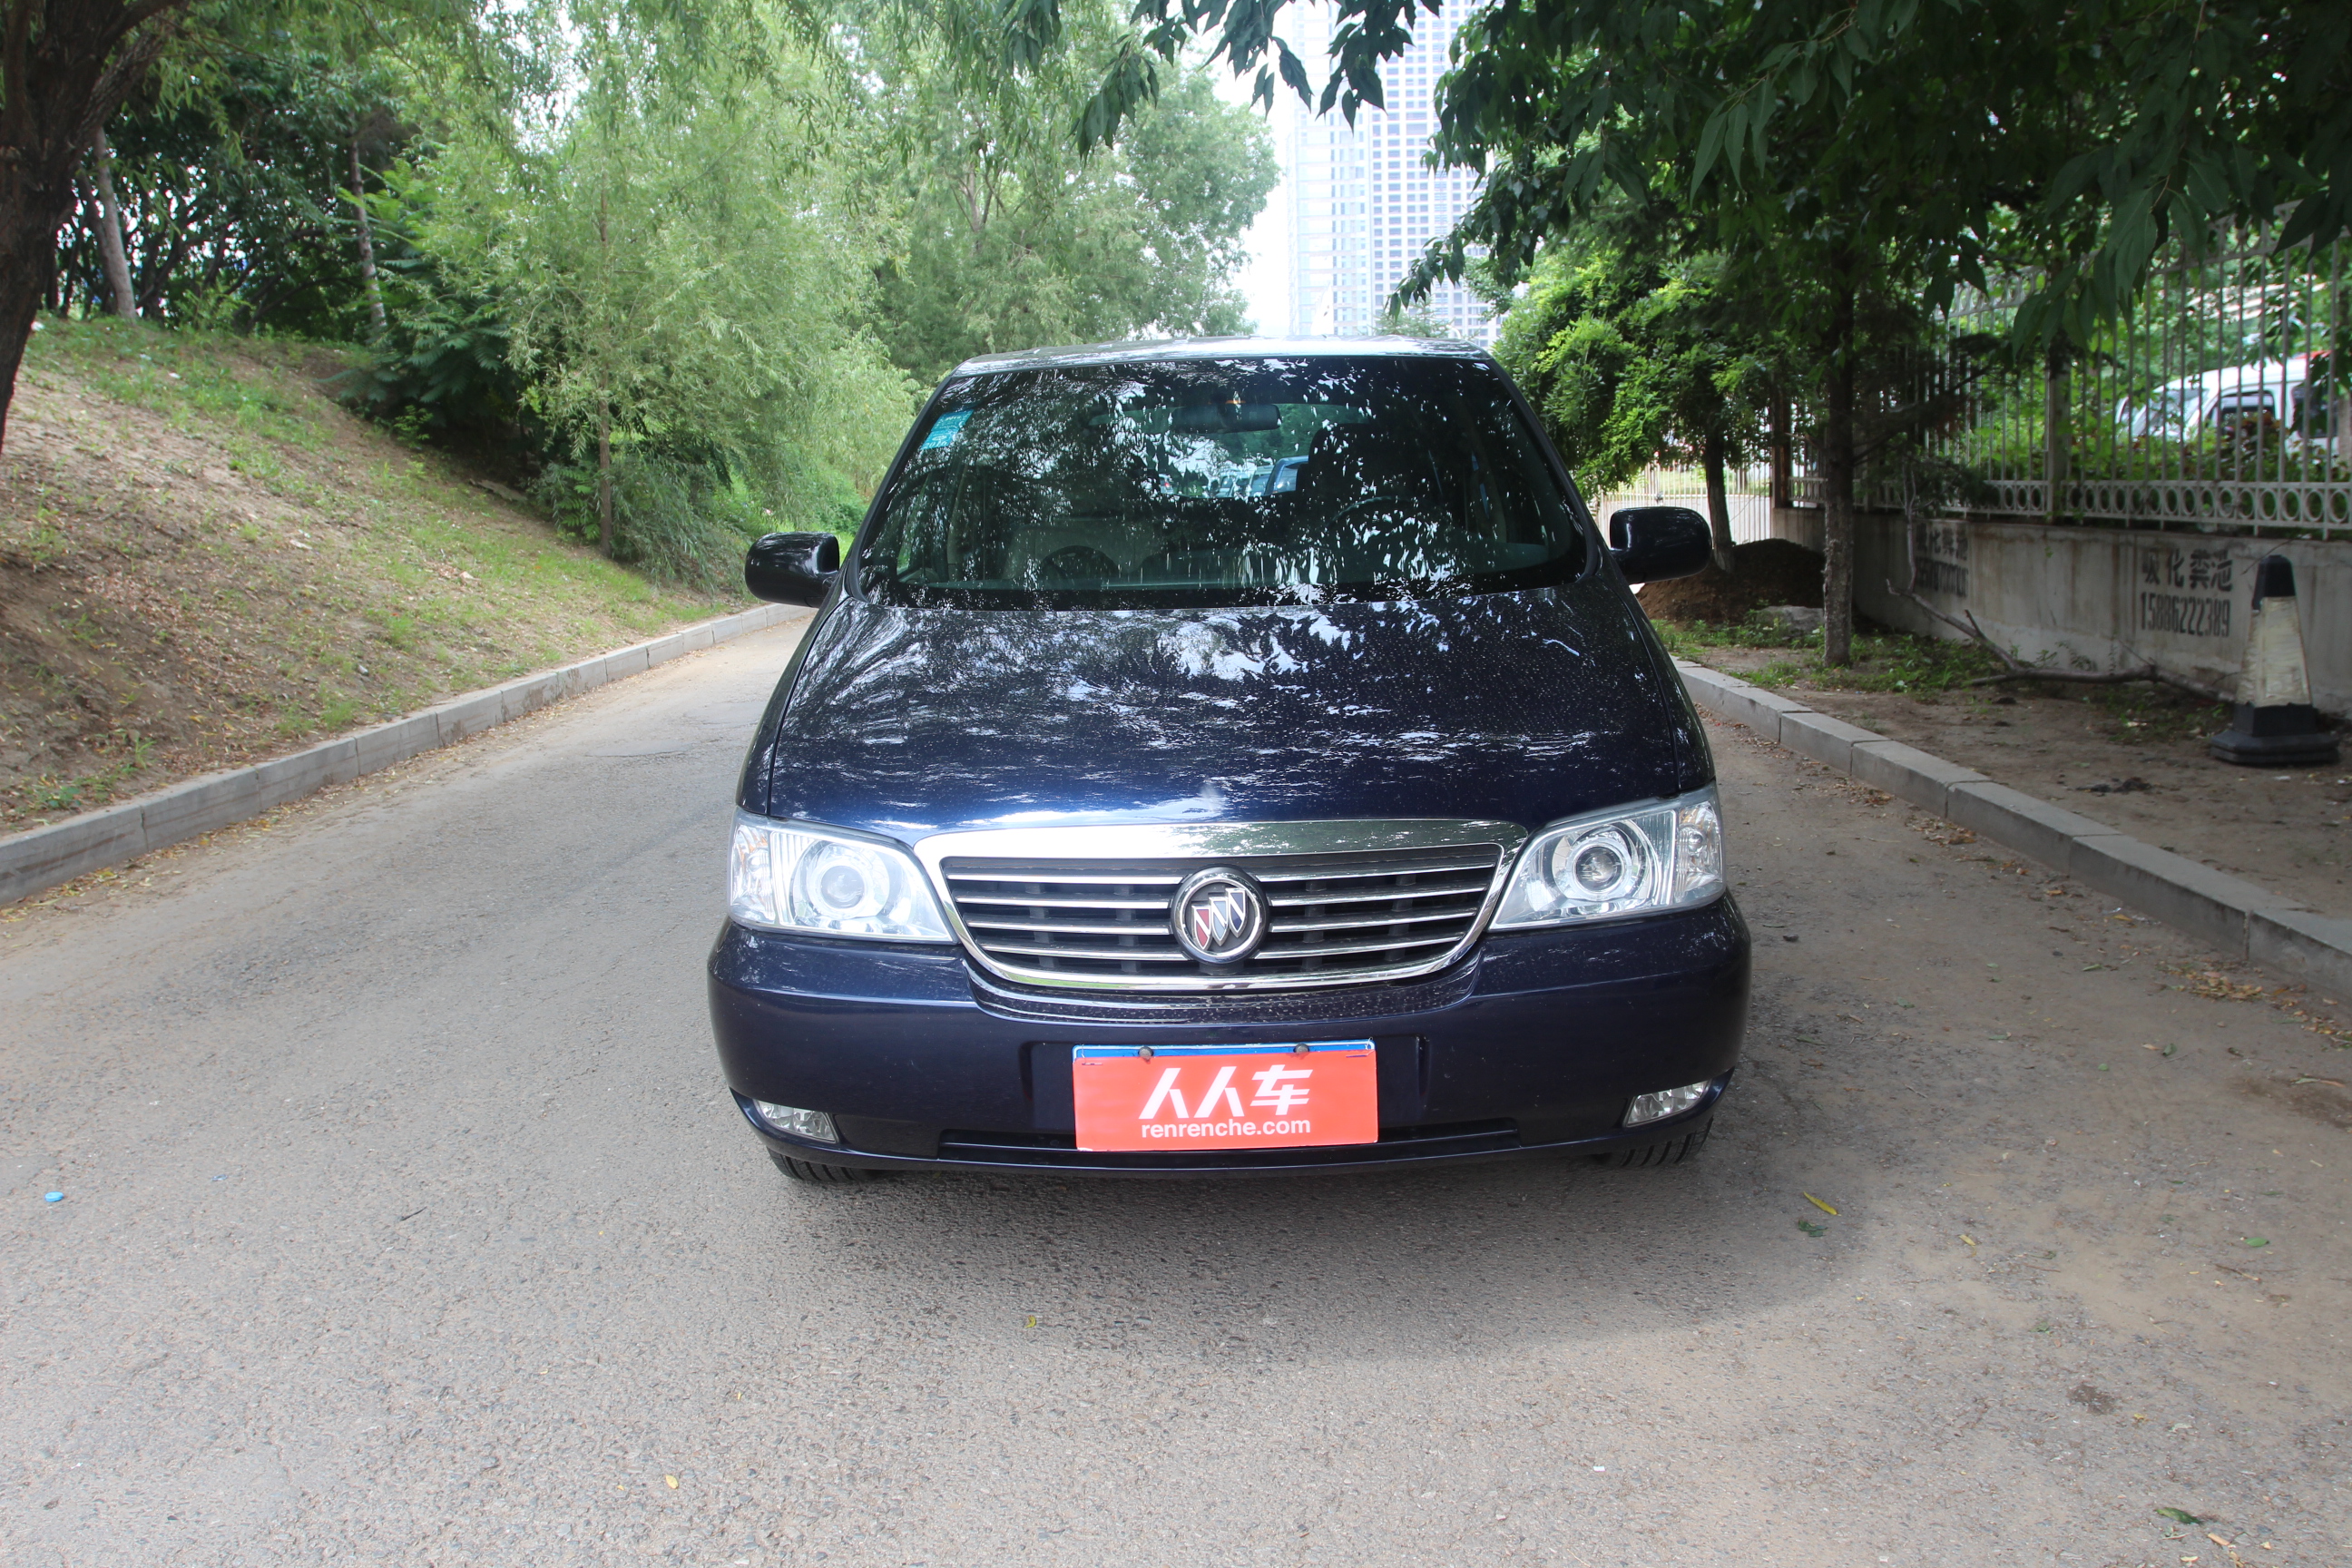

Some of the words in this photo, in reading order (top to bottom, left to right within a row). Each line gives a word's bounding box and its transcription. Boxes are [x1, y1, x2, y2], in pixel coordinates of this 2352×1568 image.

[1139, 1064, 1313, 1119] 人人车
[1142, 1118, 1310, 1138] renrenche.com
